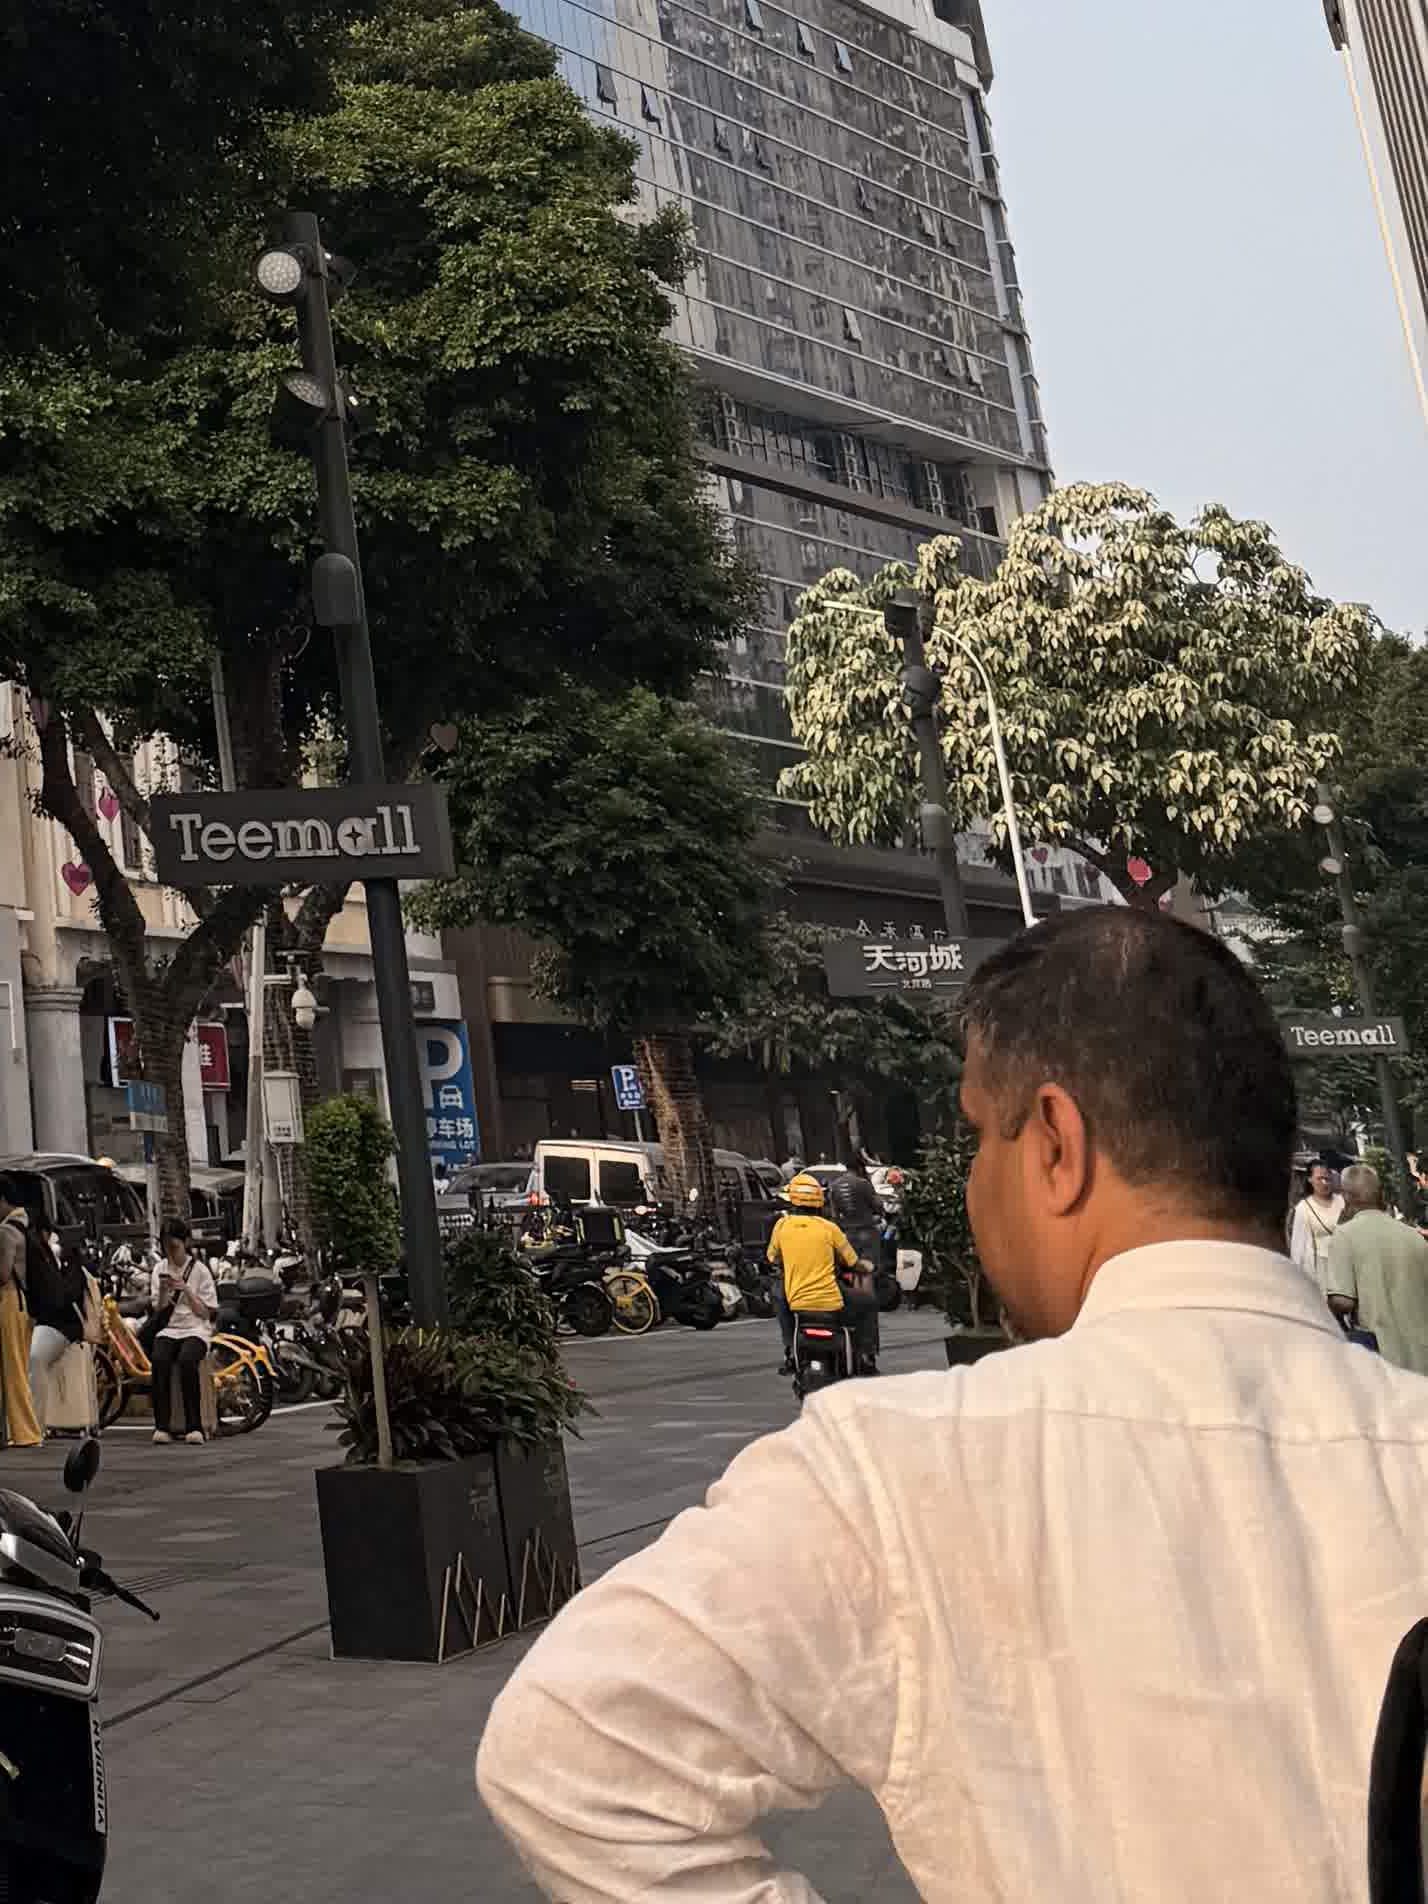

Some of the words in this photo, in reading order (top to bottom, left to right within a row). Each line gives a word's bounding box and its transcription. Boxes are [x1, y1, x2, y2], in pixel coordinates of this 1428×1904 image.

[168, 803, 421, 863] Teemall
[861, 943, 964, 977] 天河城
[1290, 1024, 1396, 1047] Teemall
[417, 1026, 464, 1109] P
[619, 1069, 637, 1091] P
